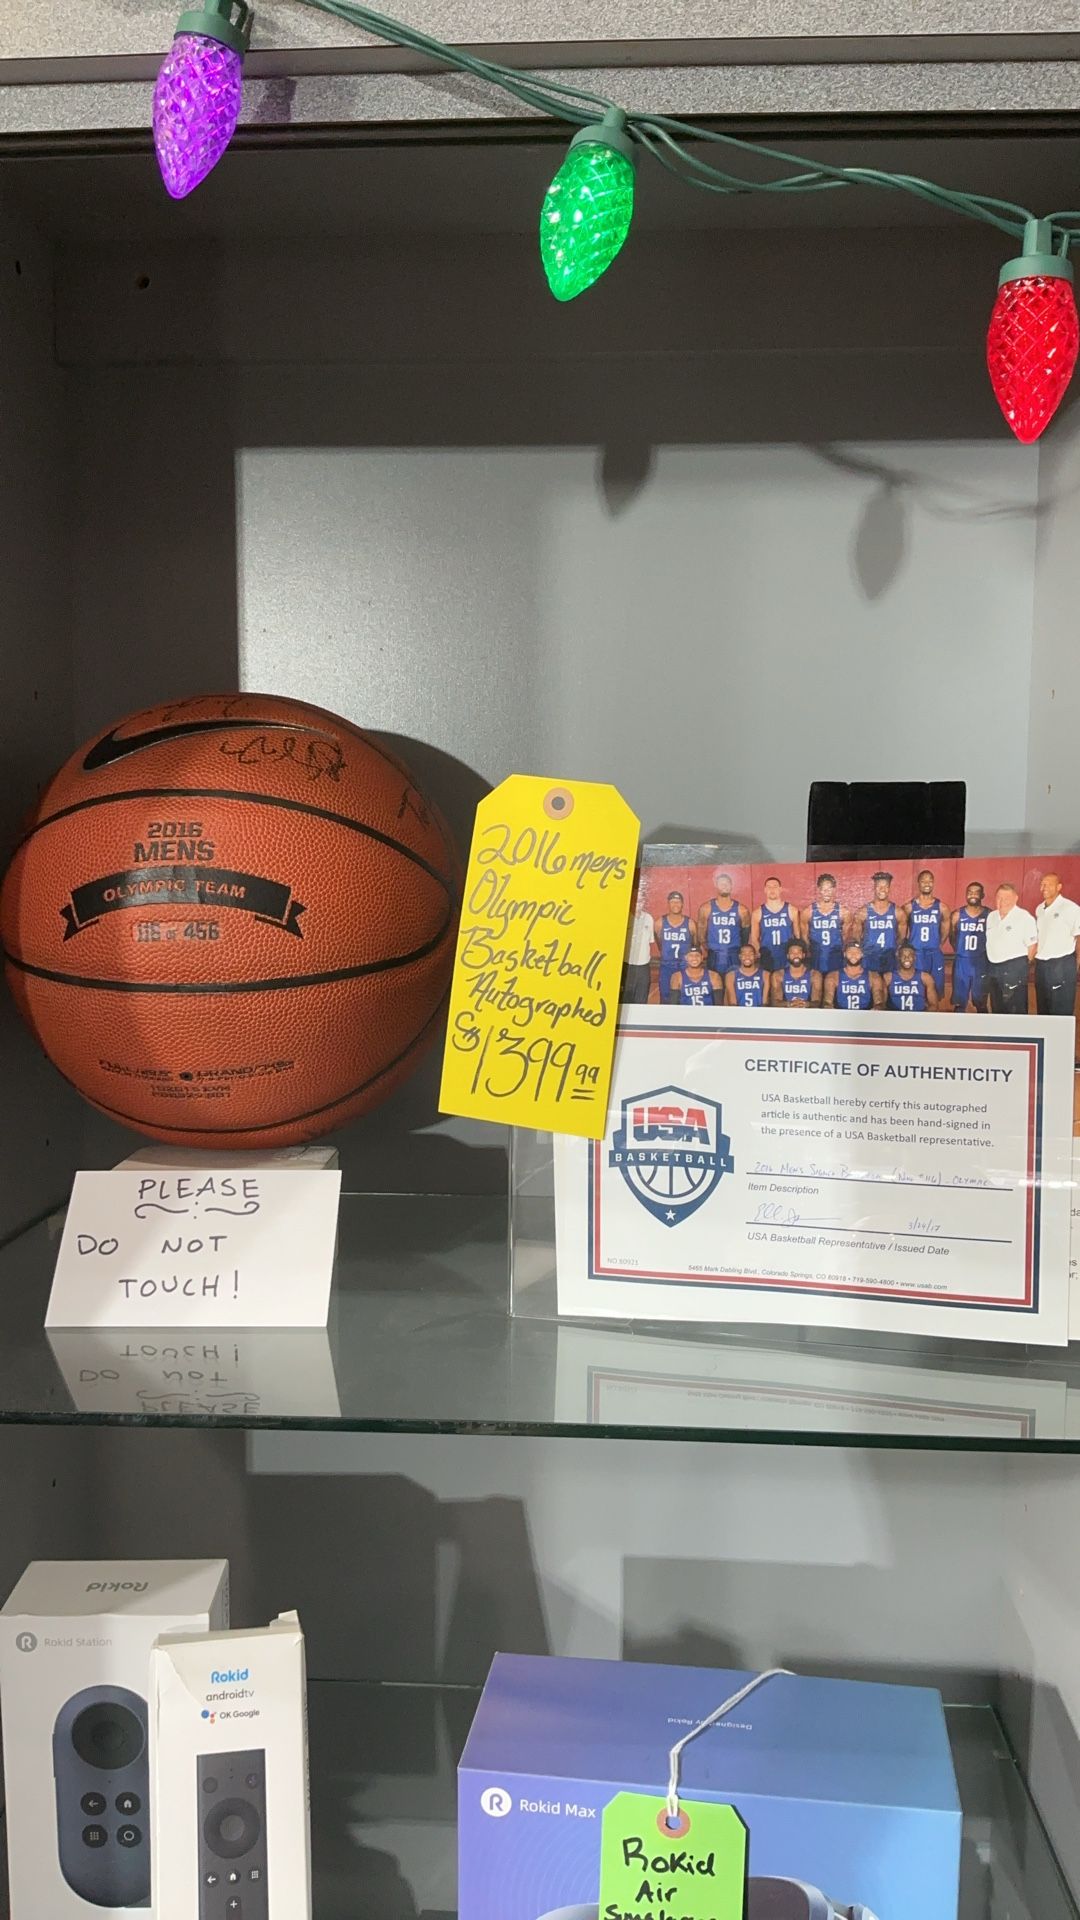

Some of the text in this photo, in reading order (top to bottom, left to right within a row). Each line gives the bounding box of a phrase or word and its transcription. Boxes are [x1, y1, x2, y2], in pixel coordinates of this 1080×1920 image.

[147, 822, 203, 838] 2016
[134, 840, 215, 863] MENS
[477, 824, 566, 875] 2016
[103, 879, 247, 903] OLYMPIC TEAM
[469, 869, 575, 940] Olympic
[713, 916, 736, 926] USA
[763, 917, 787, 927] USA
[813, 919, 837, 929] USA
[869, 919, 893, 929] USA
[913, 914, 937, 924] USA
[184, 921, 219, 941] 456
[920, 927, 929, 942] 8
[960, 922, 984, 932] USA
[663, 931, 686, 942] USA
[718, 928, 731, 944] 13
[772, 930, 781, 945] 11
[821, 931, 831, 946] 9
[876, 932, 886, 948] 4
[964, 935, 977, 951] 10
[672, 944, 680, 959] 7
[684, 986, 709, 996] USA
[737, 980, 760, 990] USA
[785, 983, 807, 994] USA
[841, 984, 866, 994] USA
[894, 984, 919, 994] USA
[466, 970, 606, 1028] Autographed
[847, 995, 860, 1010] 12
[901, 995, 914, 1010] 14
[744, 1058, 1013, 1083] CERTIFICATE OF AUTHENTICITY
[761, 1094, 988, 1114] USA Basketball hereby certify this autographed
[633, 1107, 710, 1145] USA
[761, 1110, 991, 1131] article is authentic and has been hand-signed in
[761, 1126, 777, 1135] the
[779, 1128, 821, 1137] presence
[823, 1129, 834, 1138] of
[844, 1131, 865, 1140] USA
[867, 1132, 916, 1143] Basketball
[919, 1137, 995, 1149] representative.
[615, 1152, 727, 1167] BASKETBALL
[138, 1177, 260, 1200] PLEASE
[747, 1182, 819, 1195] Item Description
[77, 1234, 228, 1255] DO NOT
[747, 1232, 768, 1241] USA
[770, 1233, 817, 1246] Basketball
[818, 1236, 887, 1251] Representative
[894, 1243, 926, 1255] Issued
[927, 1245, 950, 1256] Date
[761, 1269, 788, 1278] Colorado
[85, 1581, 149, 1593] Rokid
[43, 1637, 73, 1648] Rokid
[75, 1637, 113, 1648] Station
[211, 1668, 249, 1684] Rokid
[219, 1709, 260, 1720] OK Google
[520, 1798, 561, 1815] Rokid
[565, 1803, 597, 1818] Max
[635, 1880, 678, 1904] Air
